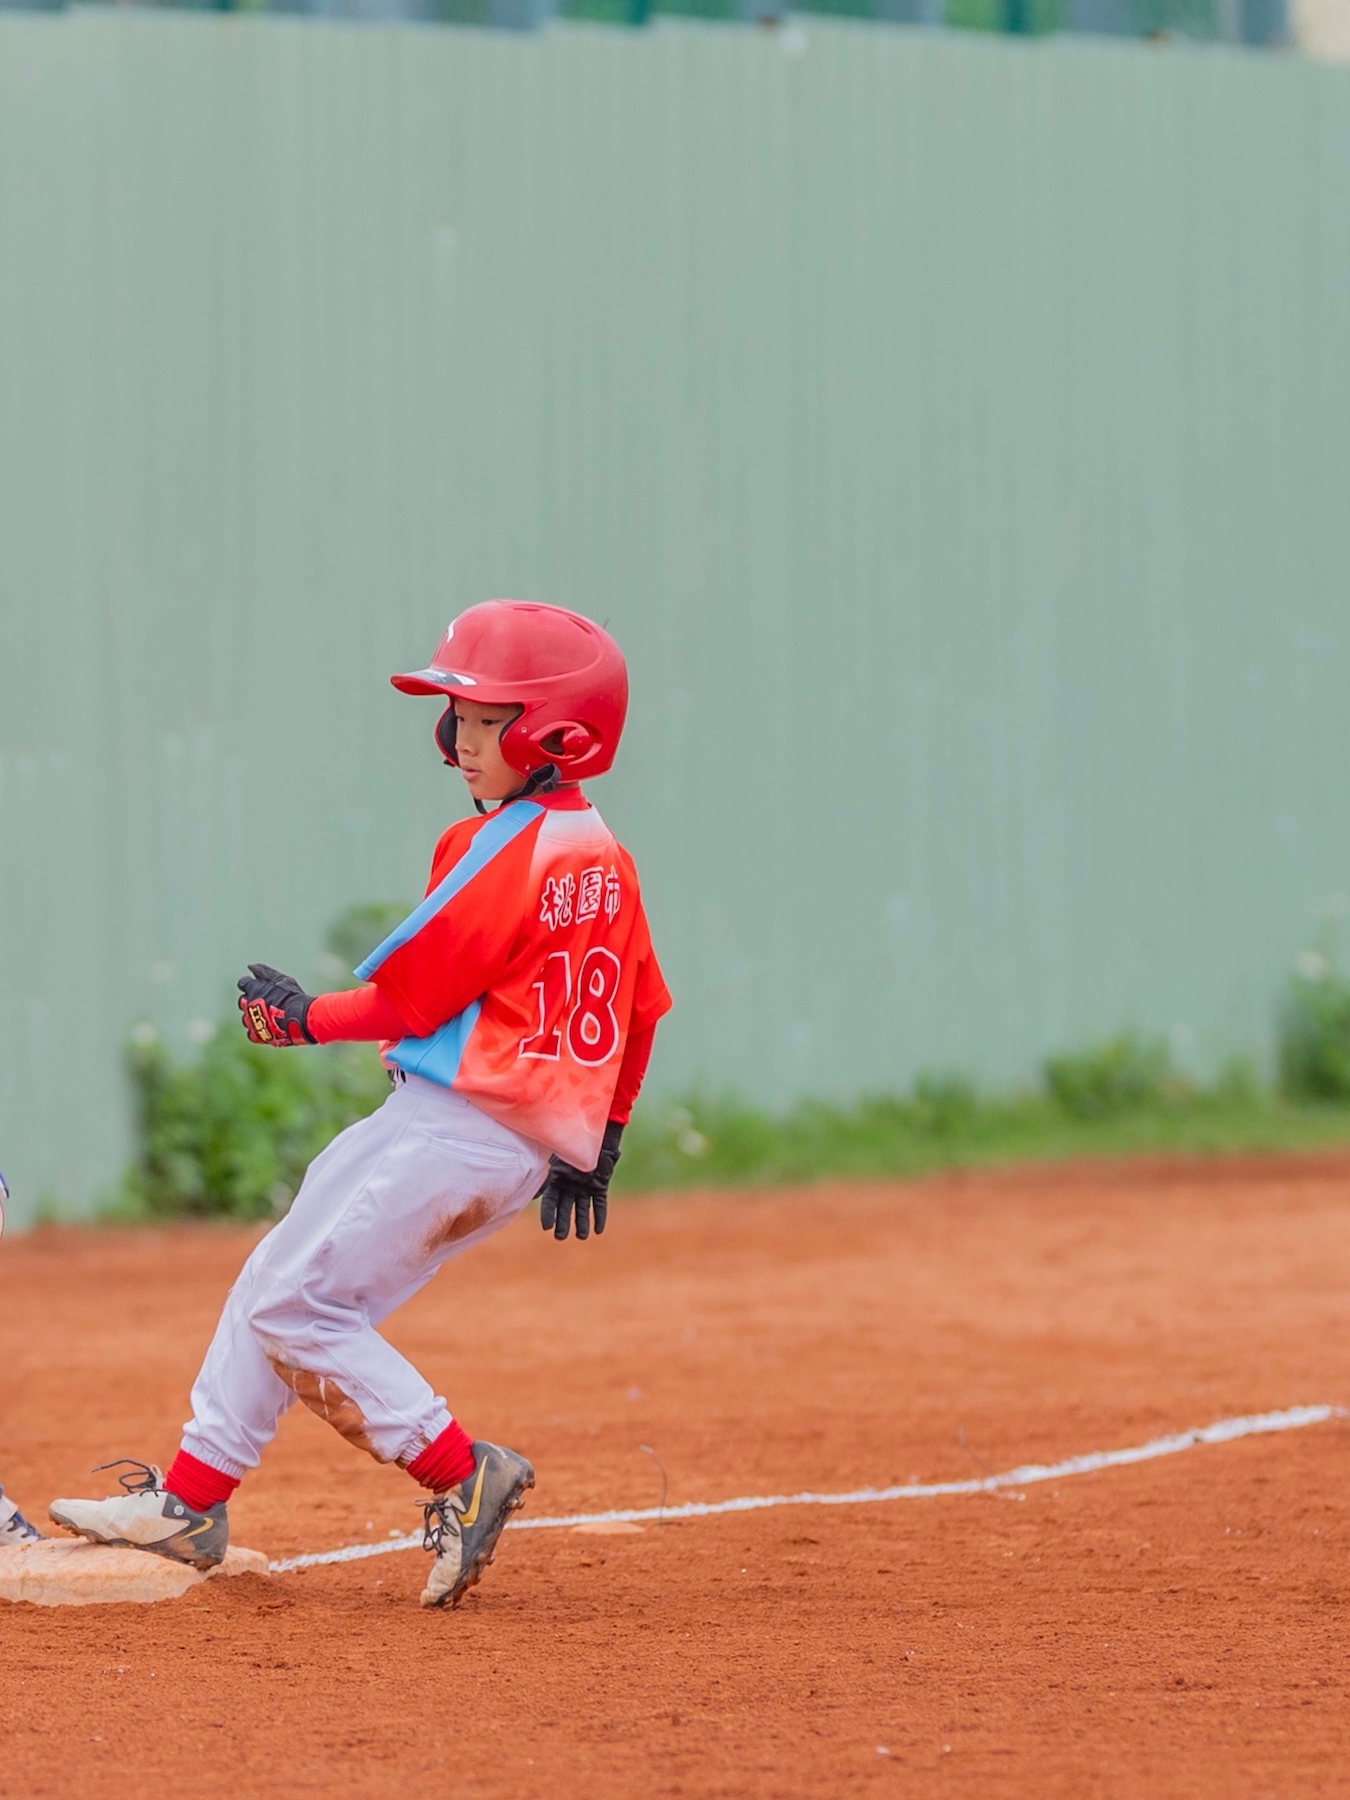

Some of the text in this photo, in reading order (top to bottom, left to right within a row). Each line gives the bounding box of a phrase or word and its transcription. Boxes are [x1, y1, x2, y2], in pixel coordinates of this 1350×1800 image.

[539, 865, 621, 932] 桃園市
[519, 946, 621, 1067] 18
